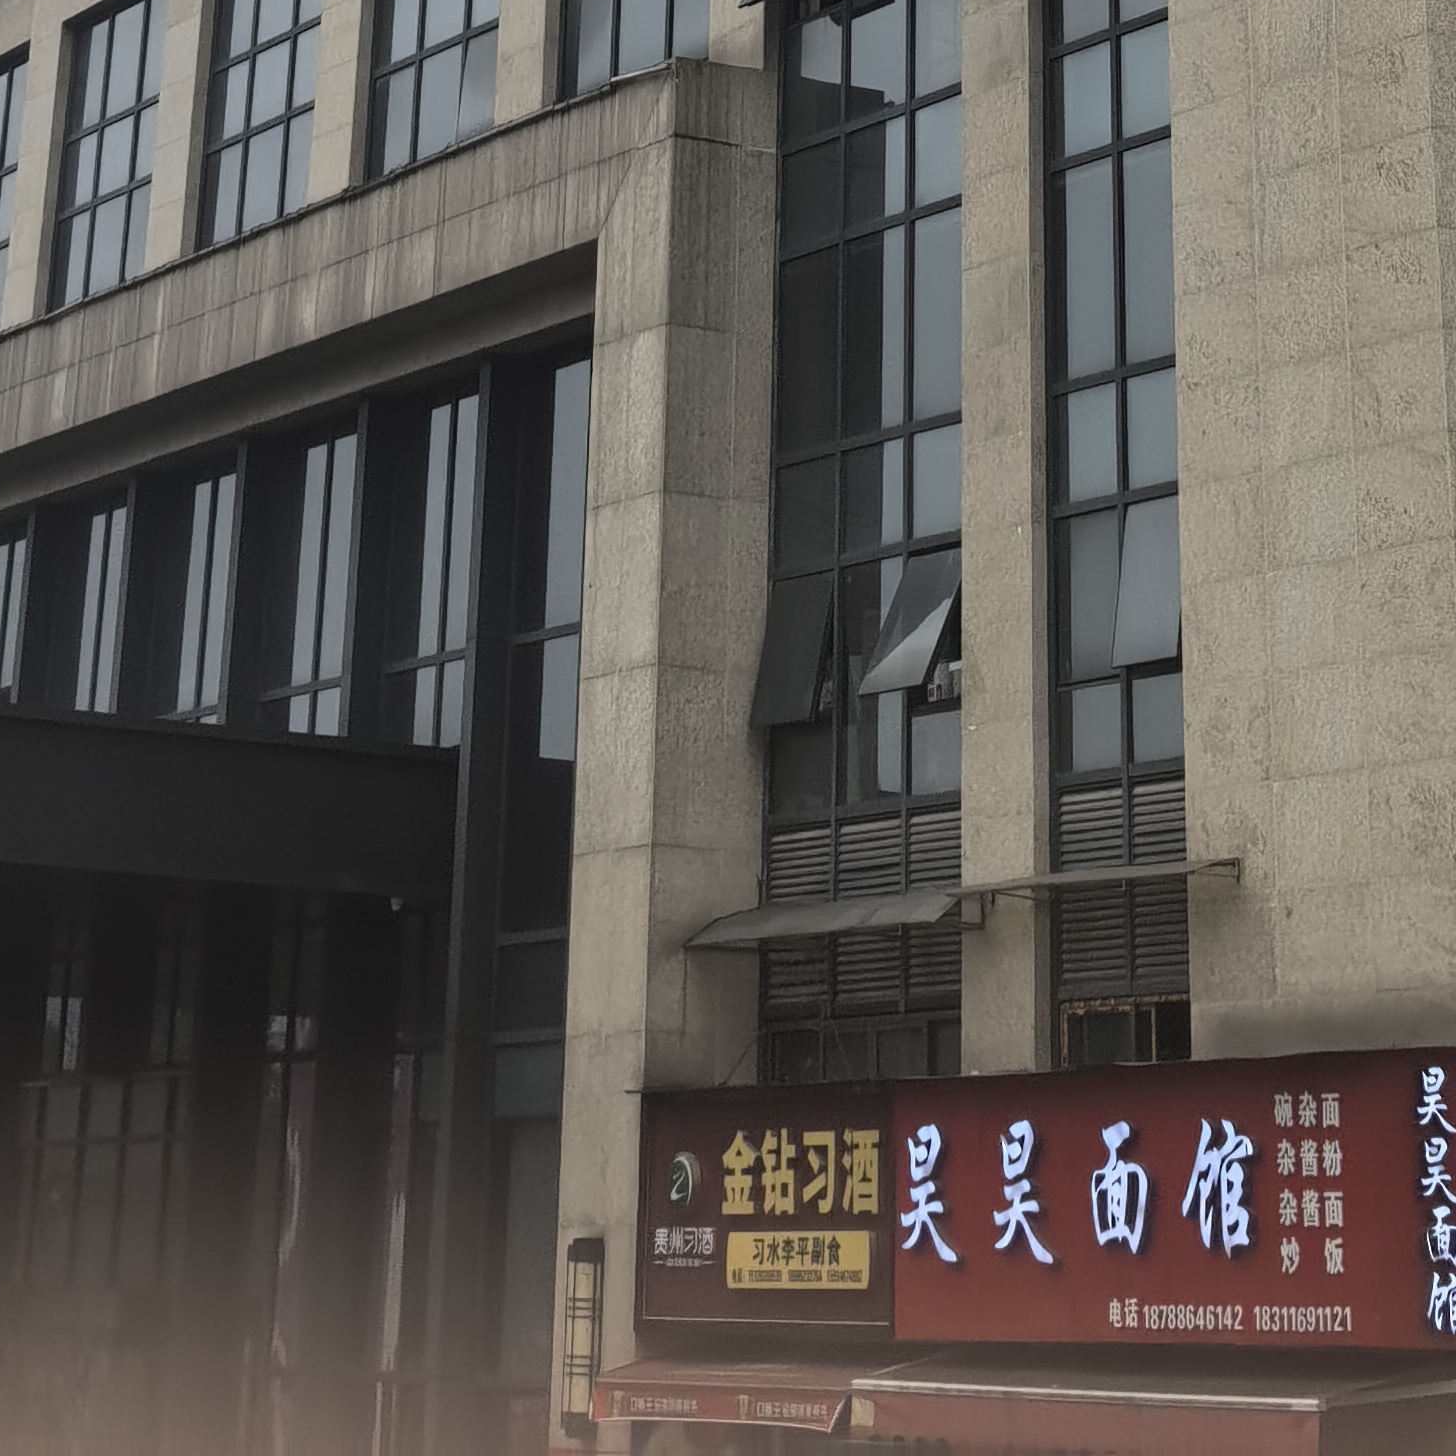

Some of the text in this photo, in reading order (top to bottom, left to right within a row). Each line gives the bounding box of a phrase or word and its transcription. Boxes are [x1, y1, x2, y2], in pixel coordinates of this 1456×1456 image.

[1273, 1090, 1341, 1129] 碗杂面
[721, 1128, 880, 1216] 金钻习酒
[1277, 1138, 1343, 1178] 杂酱粉
[900, 1118, 1253, 1265] 昊昊面馆
[1279, 1188, 1344, 1228] 杂酱面
[653, 1226, 716, 1255] 贵州习酒
[752, 1235, 842, 1267] 习水李平副食
[1252, 1305, 1352, 1333] 18311691121
